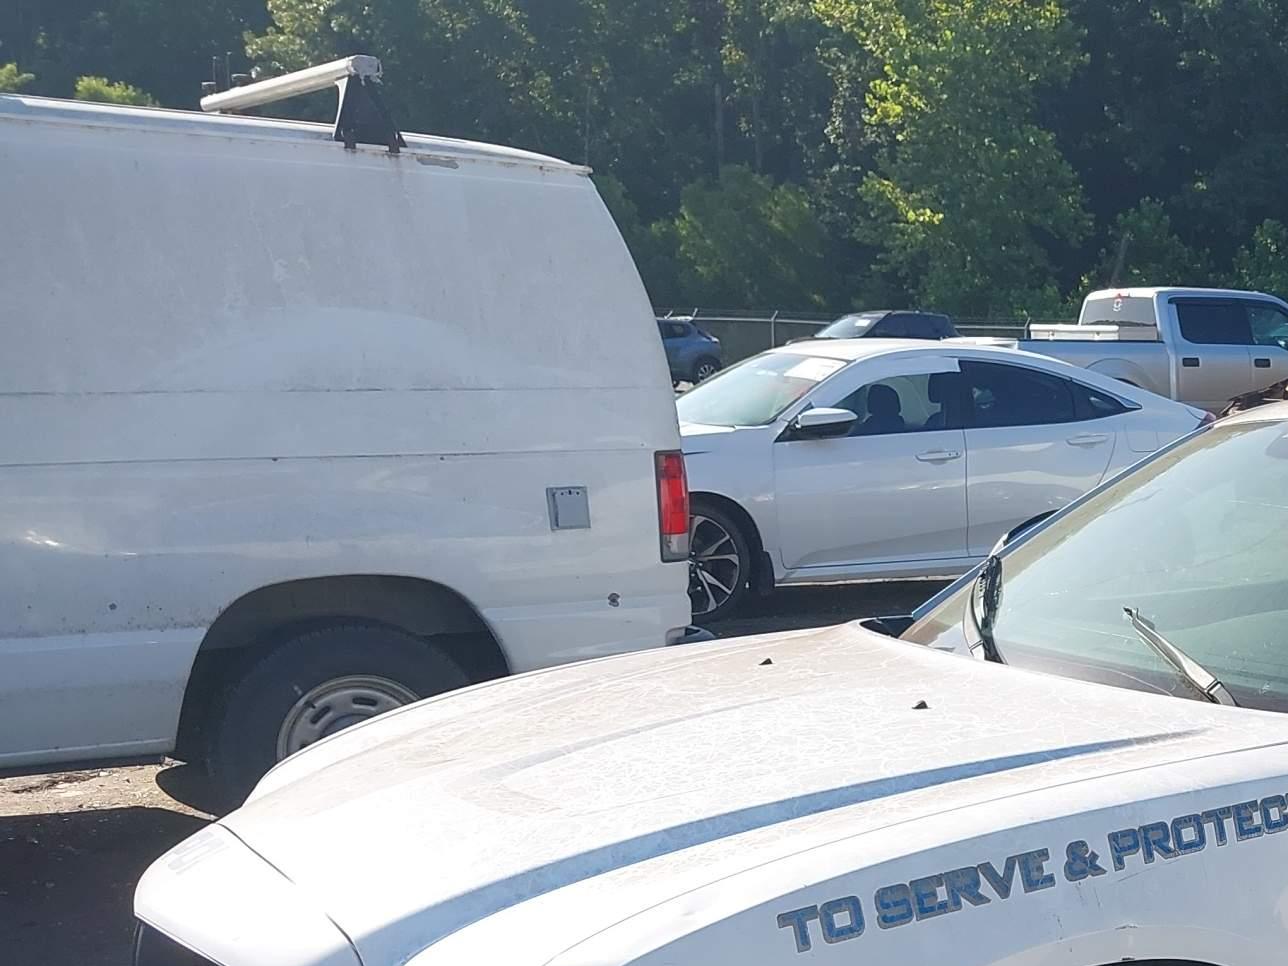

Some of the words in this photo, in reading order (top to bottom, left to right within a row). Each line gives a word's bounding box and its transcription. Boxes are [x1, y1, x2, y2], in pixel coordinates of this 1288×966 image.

[777, 896, 865, 953] TO
[874, 847, 1056, 930] SERVE
[1063, 839, 1107, 882] &
